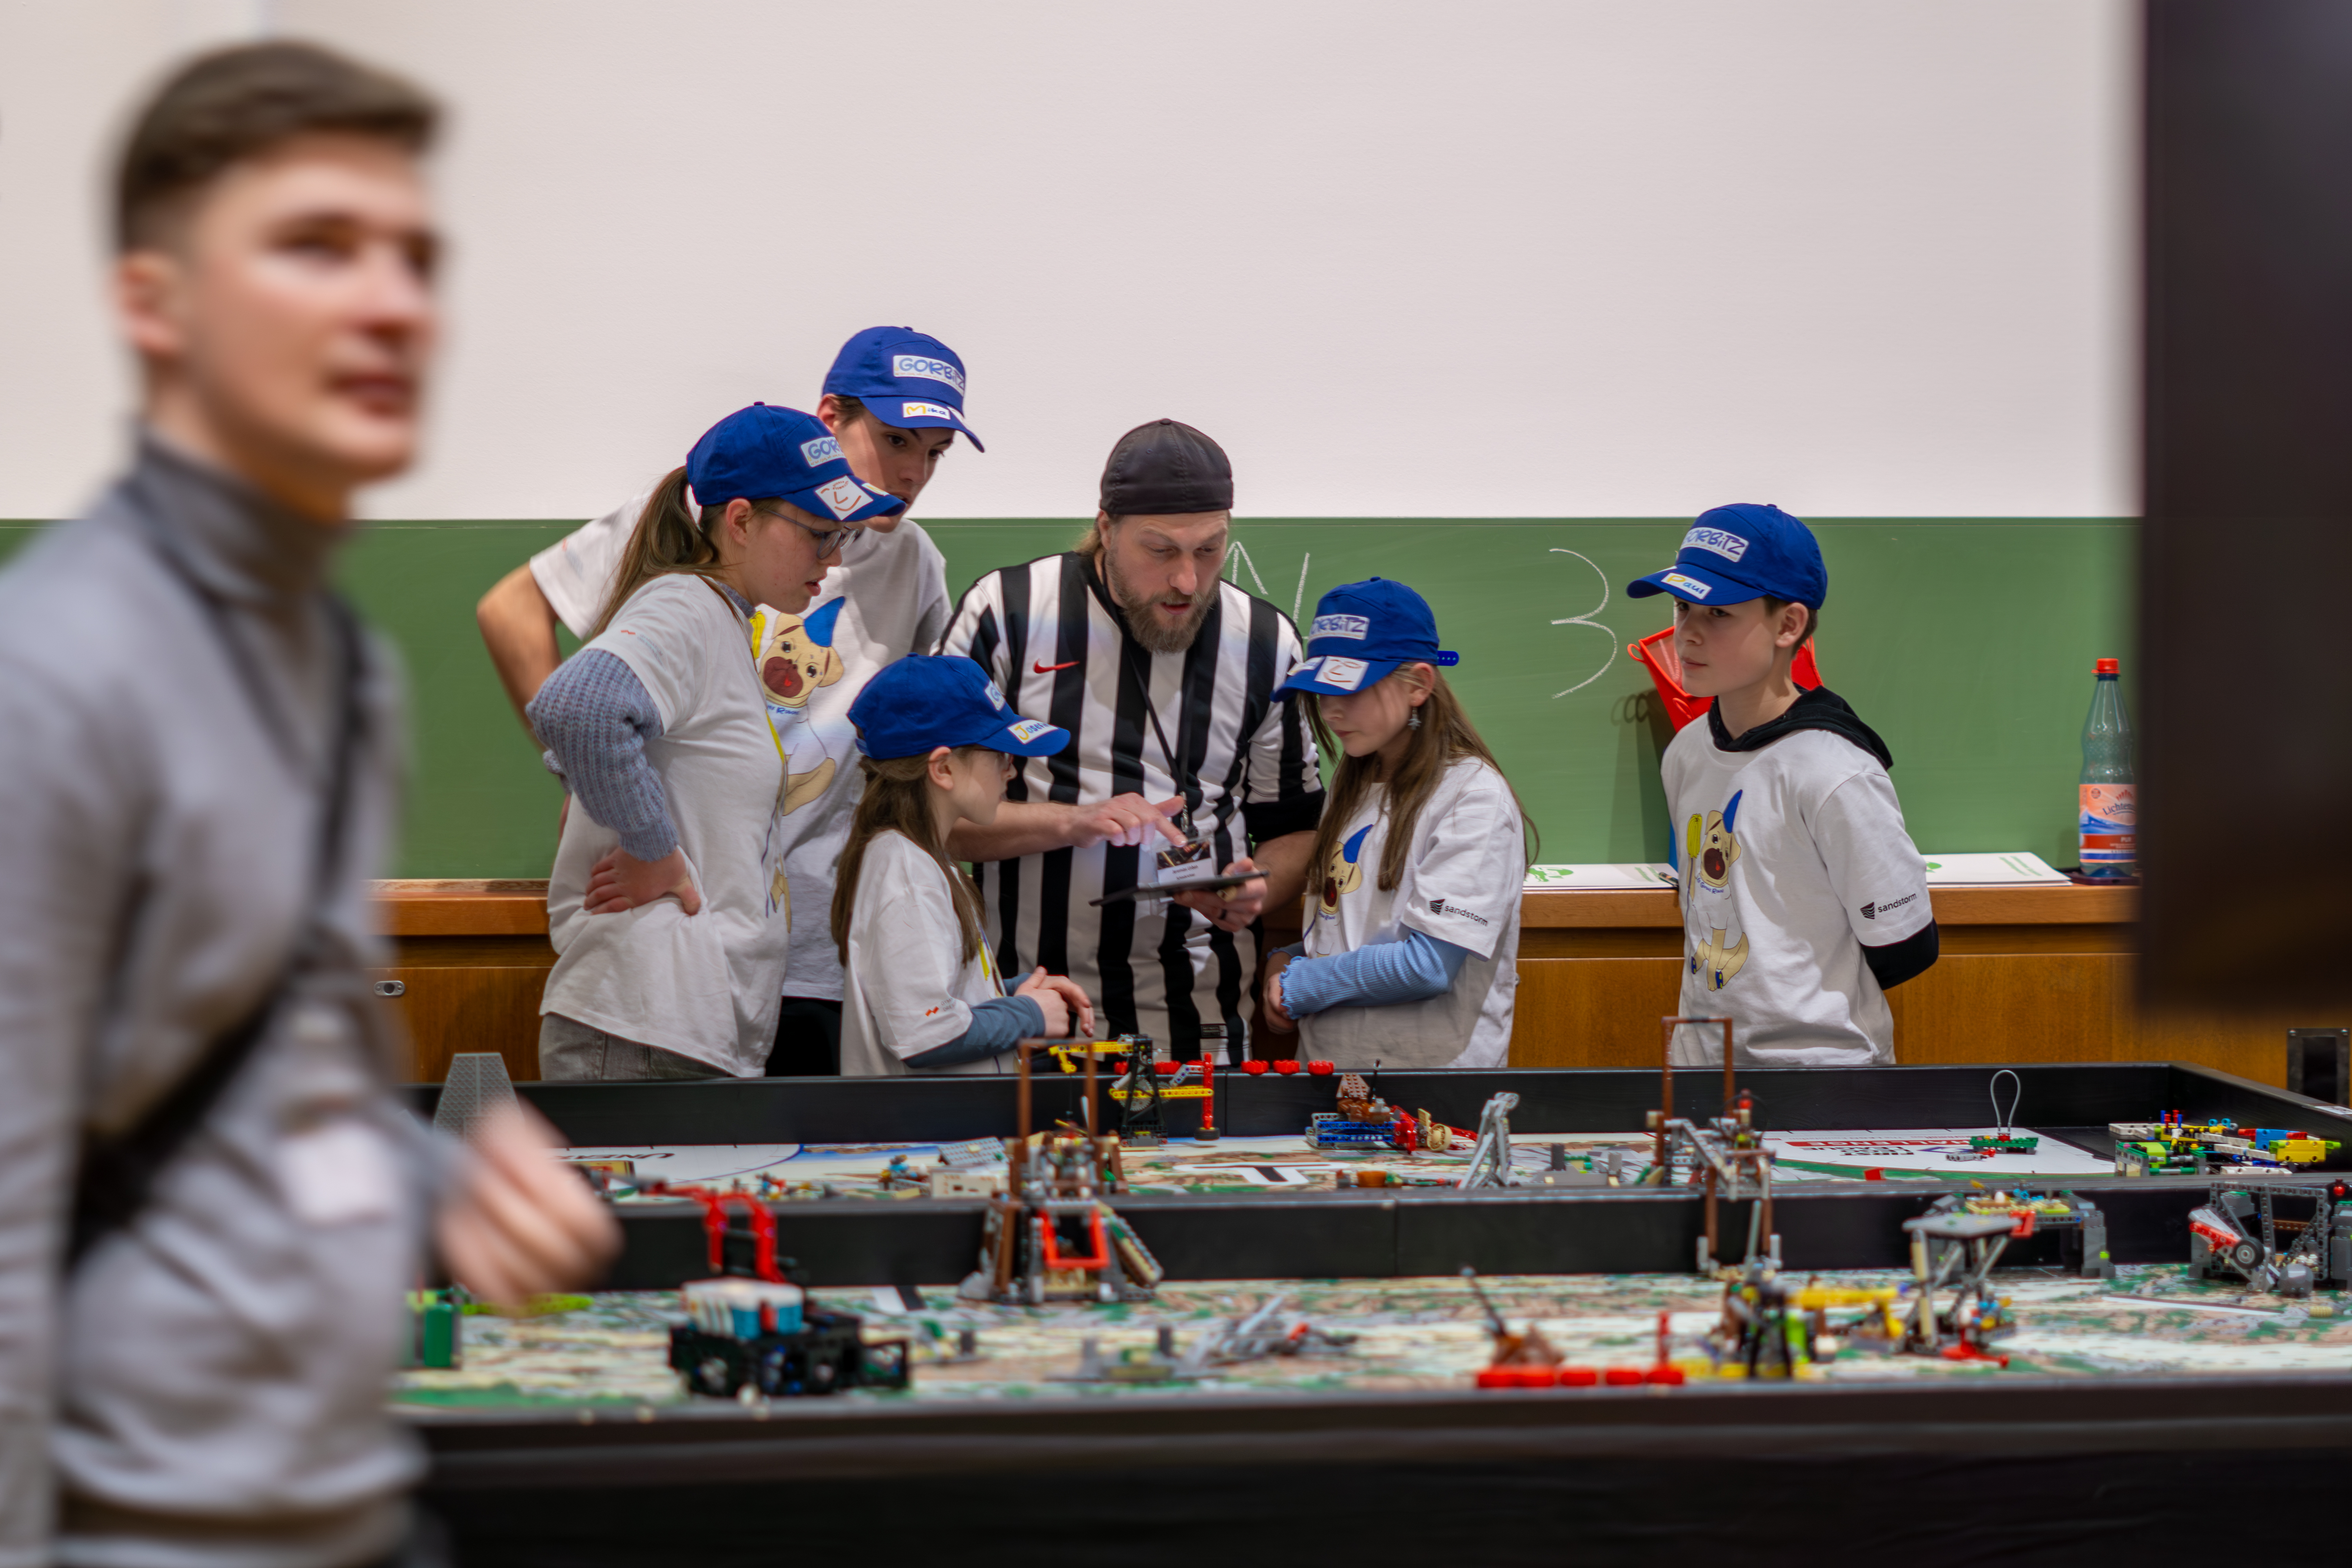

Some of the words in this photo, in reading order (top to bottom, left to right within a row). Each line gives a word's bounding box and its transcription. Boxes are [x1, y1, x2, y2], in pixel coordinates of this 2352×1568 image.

[906, 405, 947, 416] Mika
[1667, 575, 1705, 594] Paul
[1549, 548, 1618, 699] 3
[1878, 893, 1917, 913] sandstorm
[1445, 905, 1488, 927] sandstorm
